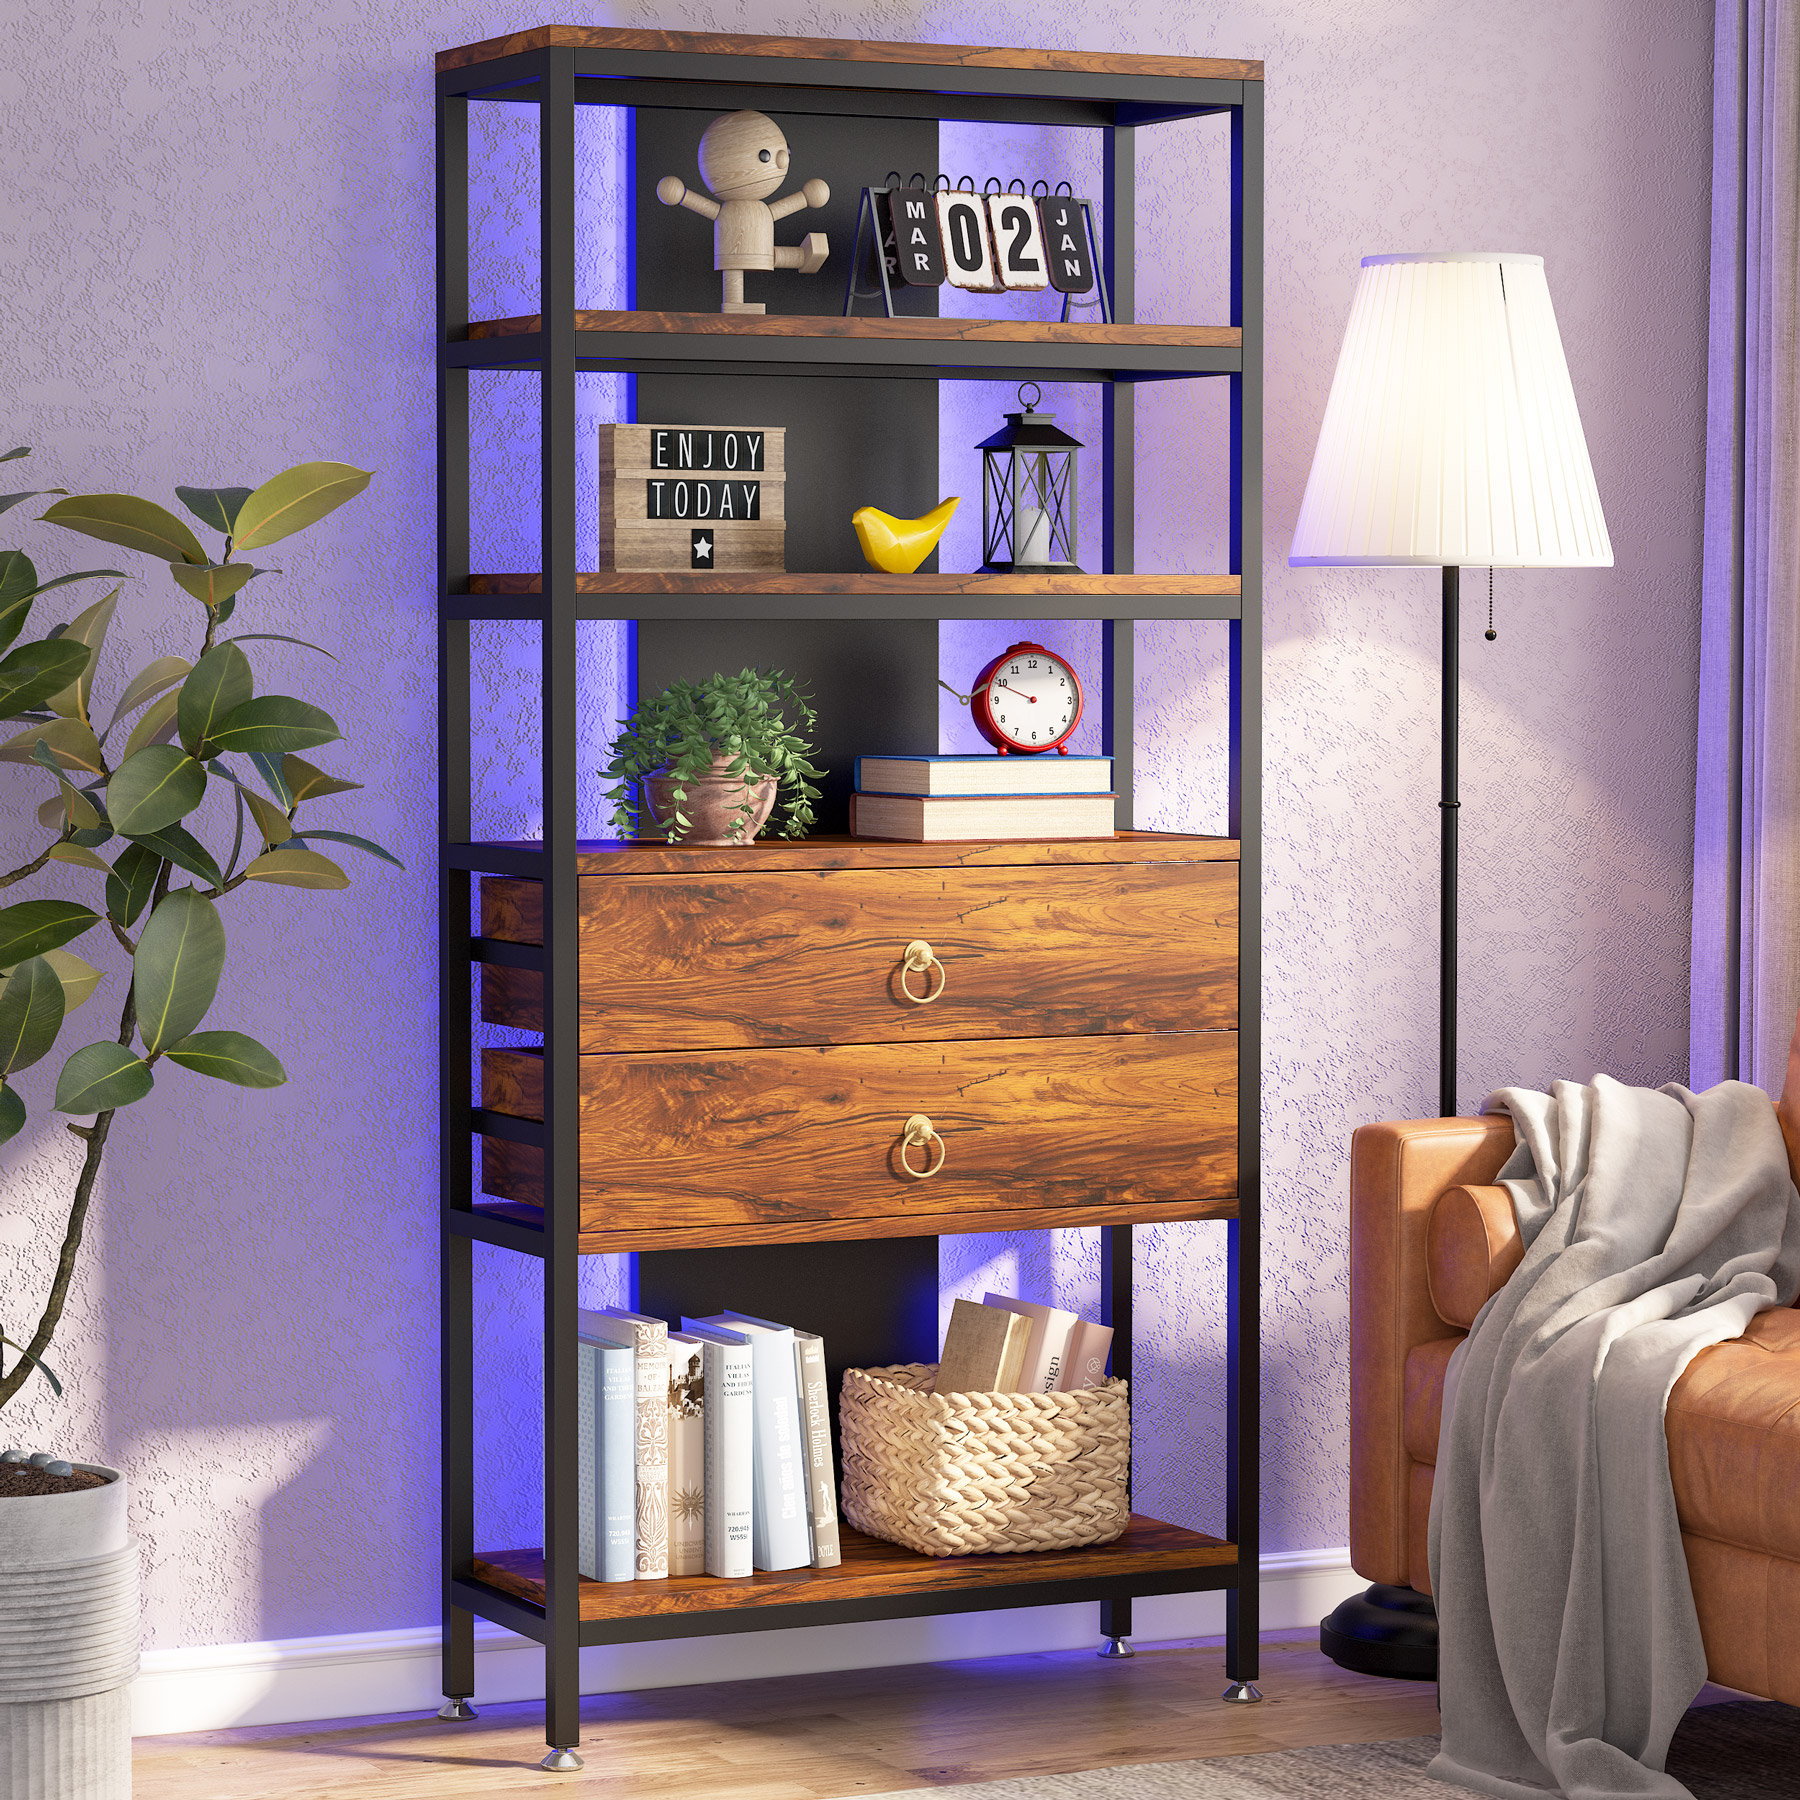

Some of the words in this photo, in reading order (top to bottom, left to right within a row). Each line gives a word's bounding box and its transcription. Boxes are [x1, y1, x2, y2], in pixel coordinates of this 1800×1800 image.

[906, 201, 930, 270] MAR
[1056, 209, 1081, 277] JAN
[656, 432, 760, 470] ENJOY
[652, 481, 757, 519] TODAY
[1028, 660, 1038, 669] 12
[1011, 665, 1020, 675] 11
[1048, 665, 1053, 674] 1
[998, 678, 1008, 687] 10
[1060, 678, 1065, 686] 2
[994, 696, 1000, 705] 9
[1067, 696, 1073, 705] 3
[1000, 714, 1006, 723] 8
[1061, 714, 1067, 723] 4
[1014, 727, 1019, 736] 7
[1049, 726, 1055, 735] 5
[1031, 731, 1037, 740] 6
[1043, 1356, 1060, 1394] sign
[807, 1380, 825, 1427] Sherlock
[811, 1428, 828, 1468] Holmes
[817, 1544, 834, 1558] DOYLE
